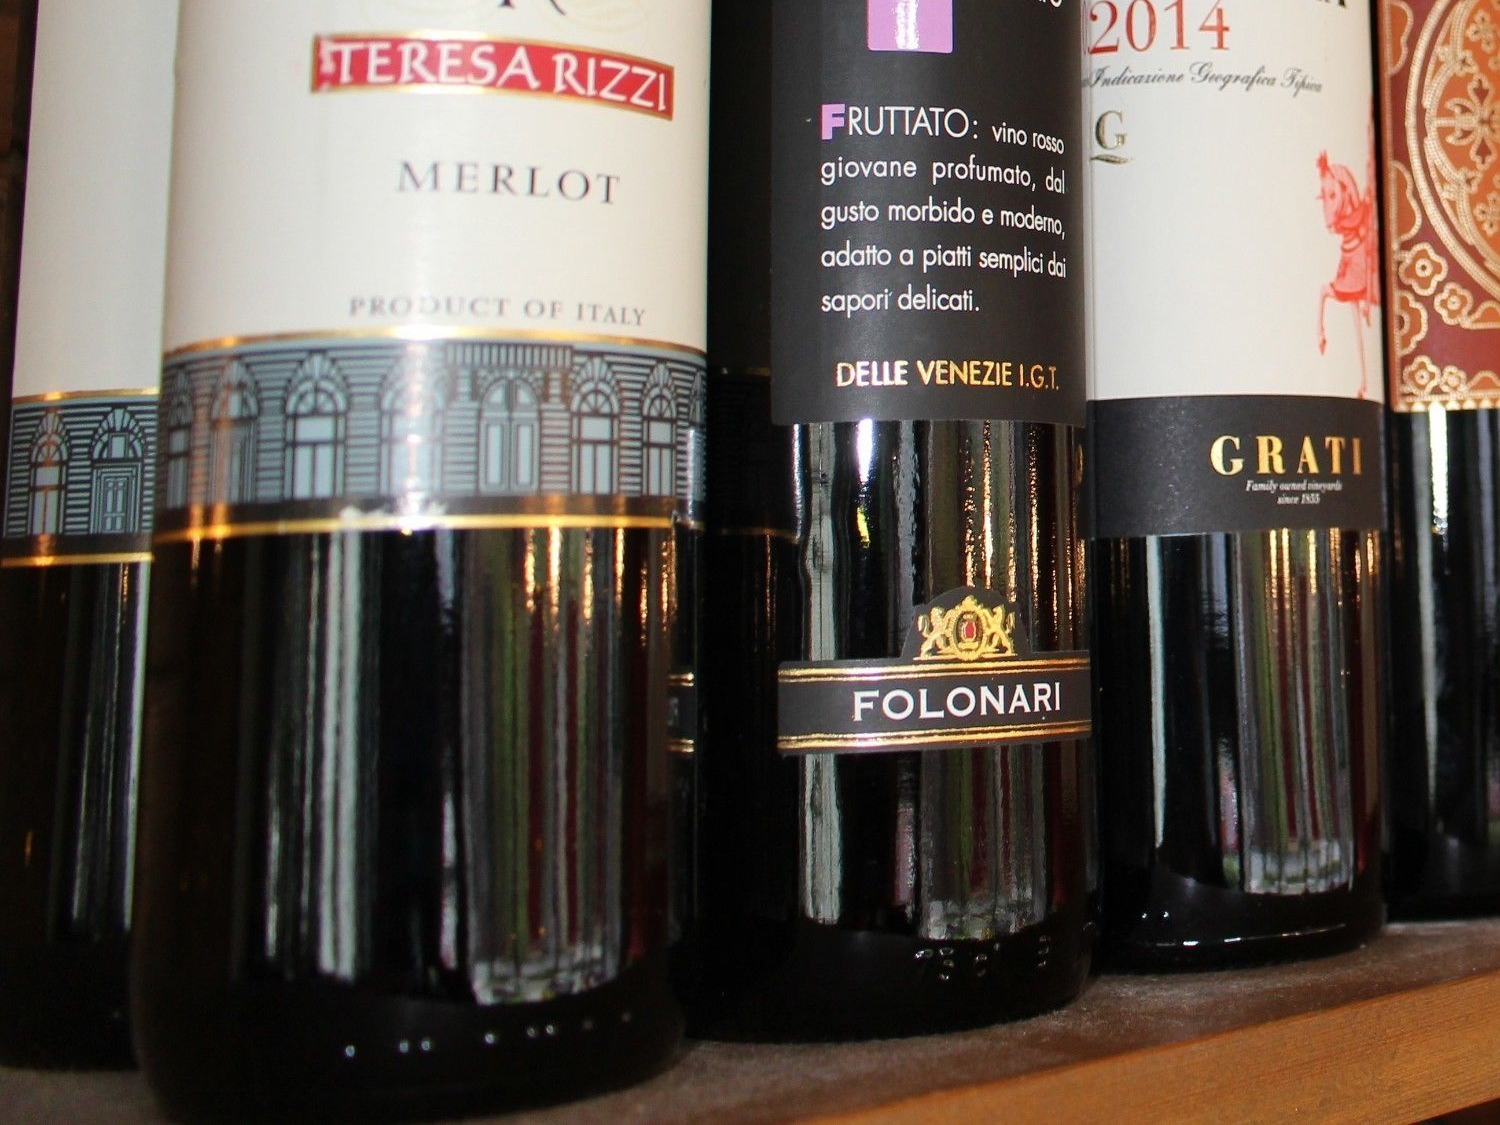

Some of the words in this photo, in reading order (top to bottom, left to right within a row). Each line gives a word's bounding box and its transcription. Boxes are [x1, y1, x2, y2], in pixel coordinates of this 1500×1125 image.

[329, 40, 541, 91] TERESA
[551, 51, 668, 113] RIZZI
[1087, 64, 1185, 89] Indicazione
[1188, 61, 1277, 92] Geografica
[1280, 67, 1323, 98] Tipica
[820, 103, 979, 140] FRUTTATO:
[991, 122, 1028, 147] vino
[1032, 133, 1065, 155] rosso
[1095, 109, 1129, 152] G
[396, 160, 621, 205] MERLOT
[820, 156, 918, 186] giovane
[931, 153, 1037, 192] profumato,
[1045, 167, 1066, 195] dal
[820, 200, 880, 230] gusto
[888, 195, 976, 224] morbido
[981, 208, 995, 225] e
[1000, 205, 1067, 240] moderno,
[820, 239, 892, 267] adatto
[898, 250, 914, 266] a
[922, 244, 972, 274] piatti
[978, 245, 1044, 278] semplici
[1047, 251, 1067, 279] dai
[349, 295, 511, 318] PRODUCT
[523, 299, 564, 320] OF
[576, 302, 647, 326] ITALY
[820, 289, 891, 319] sapori
[897, 283, 980, 312] delicati.
[836, 359, 909, 388] DELLE
[915, 359, 1013, 387] VENEZIE
[1018, 364, 1060, 391] I.G.T.
[1209, 434, 1363, 476] GRATI
[1245, 479, 1279, 494] Family
[1279, 479, 1307, 491] owned
[1277, 494, 1299, 505] since
[852, 681, 1062, 723] FOLONARI
